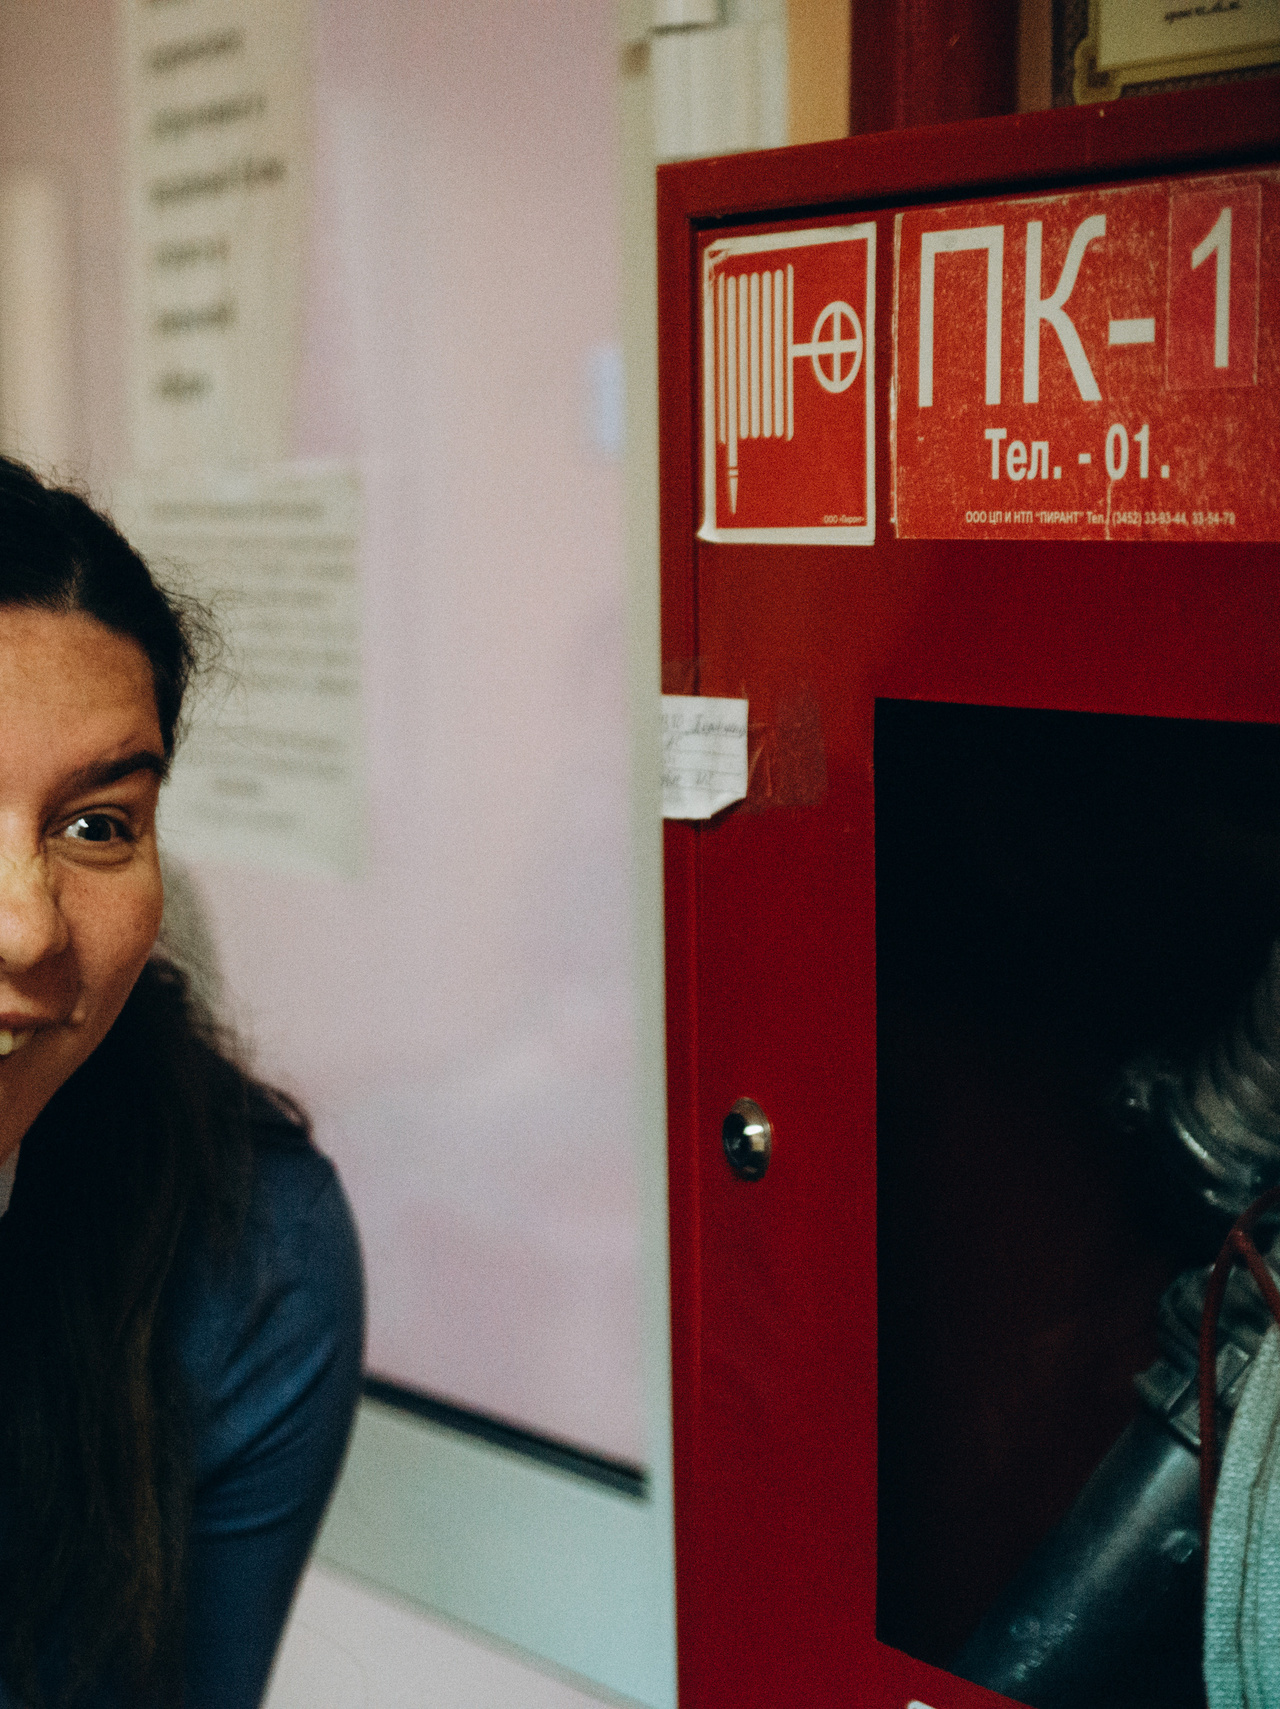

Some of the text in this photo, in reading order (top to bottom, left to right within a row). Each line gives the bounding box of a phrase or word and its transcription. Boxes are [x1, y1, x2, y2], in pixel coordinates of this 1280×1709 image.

[984, 427, 1062, 481] Тел.
[1105, 423, 1170, 480] 01.
[965, 510, 987, 524] ООО
[988, 510, 1003, 525] ЦП
[1004, 510, 1012, 524] И
[1013, 510, 1034, 524] НТП
[1111, 510, 1142, 527] (3452)
